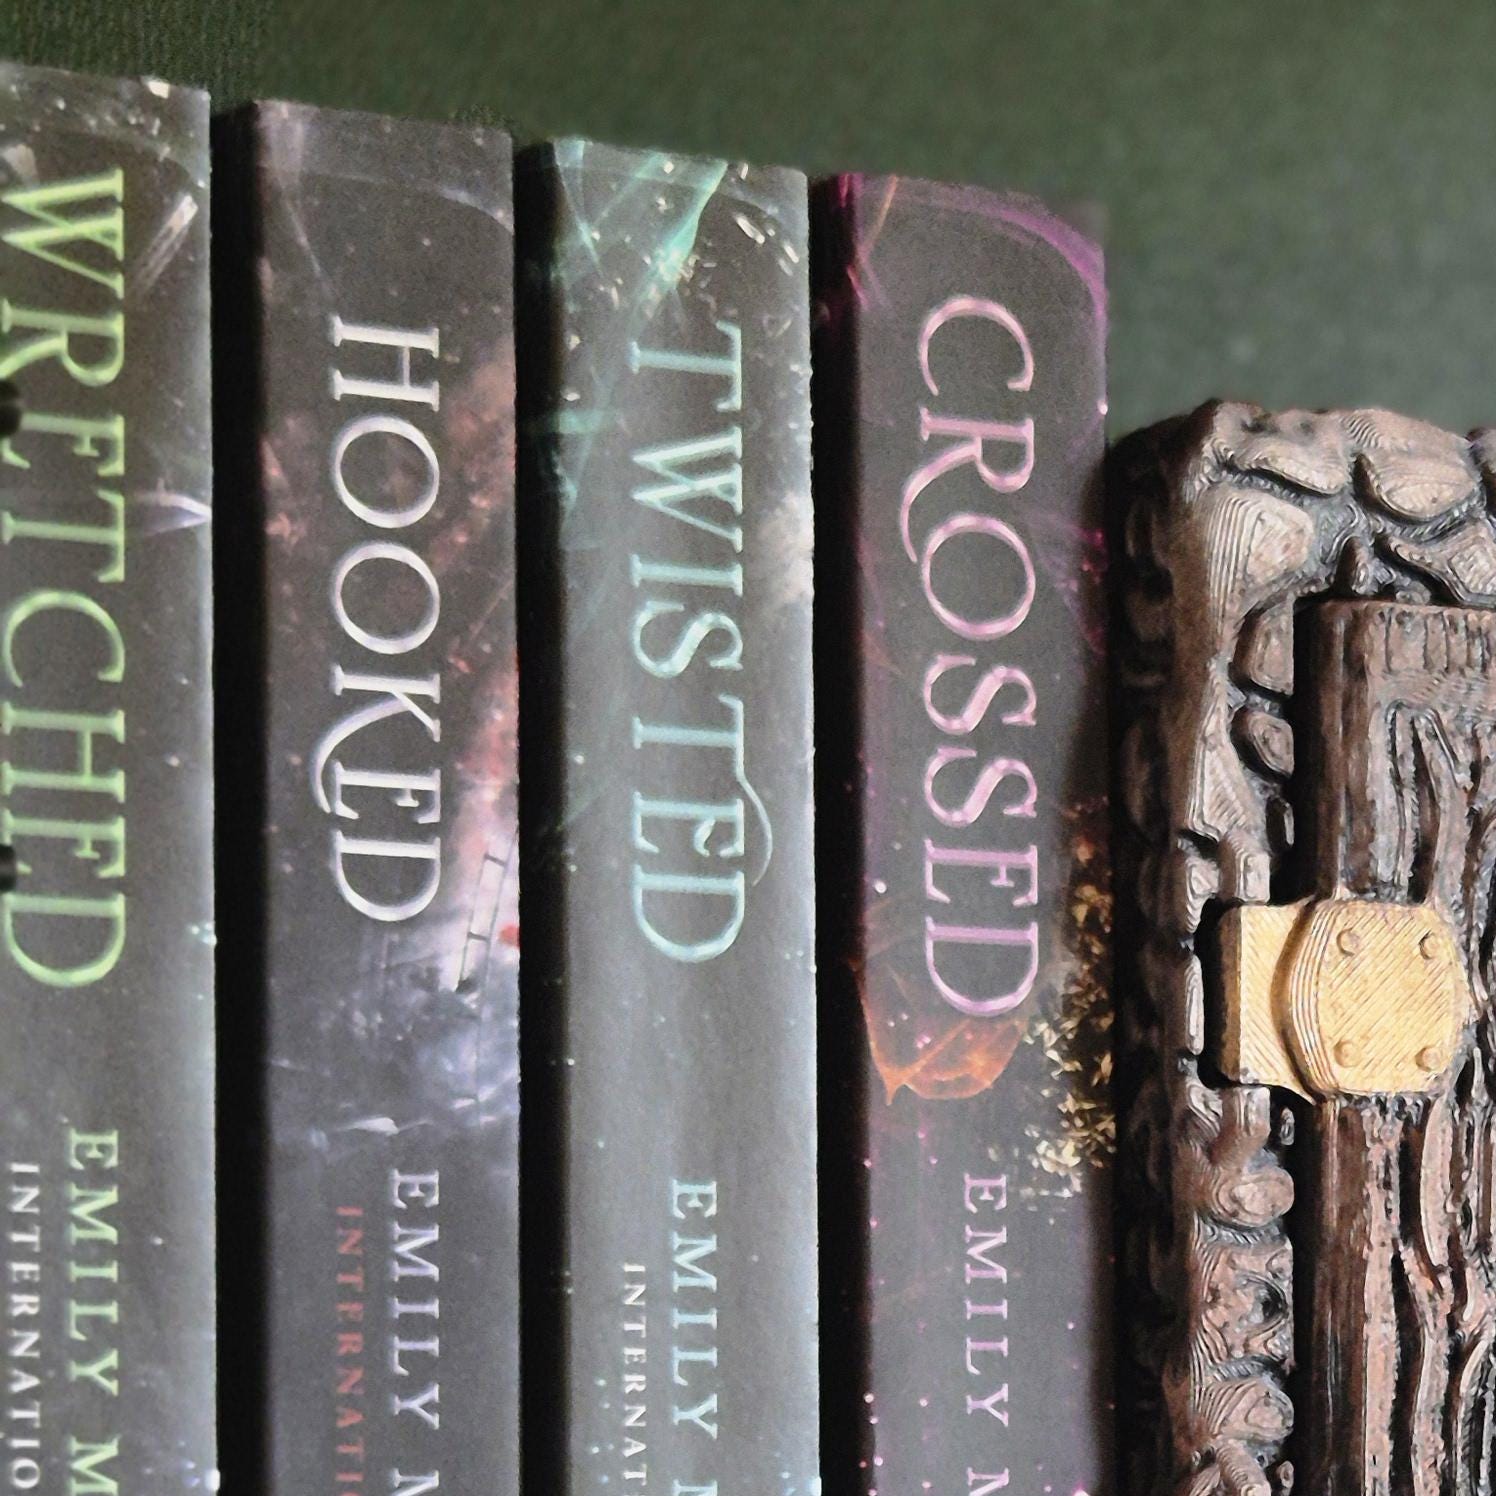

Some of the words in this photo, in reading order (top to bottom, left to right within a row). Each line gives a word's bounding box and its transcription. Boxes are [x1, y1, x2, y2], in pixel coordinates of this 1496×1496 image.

[0, 169, 124, 988] WRETCHED
[313, 315, 441, 923] HOOKED
[628, 320, 774, 963] TWISTED
[901, 296, 1039, 1017] CROSSED
[68, 1128, 119, 1397] EMILY
[390, 1168, 440, 1430] EMILY
[671, 1179, 718, 1440] EMILY
[963, 1174, 1010, 1427] EMILY
